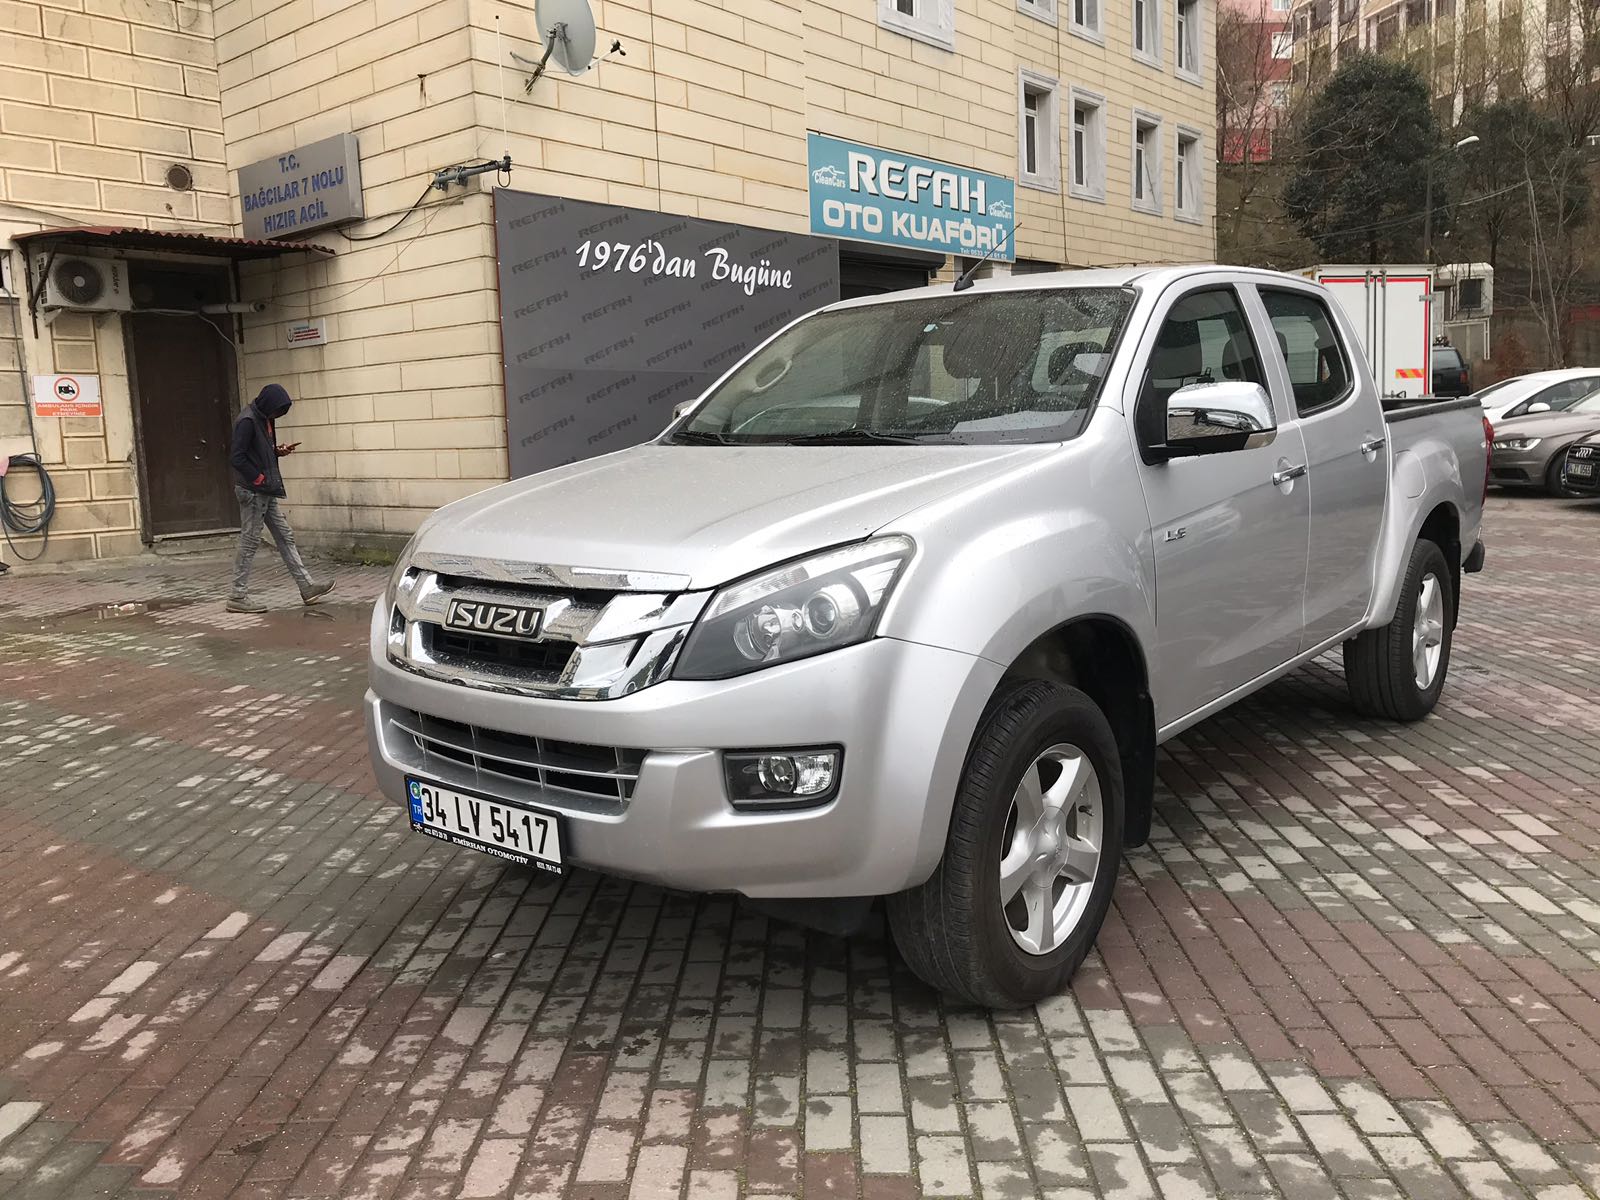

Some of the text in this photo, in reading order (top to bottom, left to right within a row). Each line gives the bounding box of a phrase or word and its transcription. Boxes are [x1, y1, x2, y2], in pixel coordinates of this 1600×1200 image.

[279, 154, 300, 173] T.C.
[302, 177, 308, 195] 7
[311, 166, 345, 192] NOLU
[848, 151, 987, 215] REFAH
[264, 209, 297, 233] HIZIR
[508, 203, 565, 230] REFAH
[577, 213, 630, 238] REFAH
[823, 199, 1007, 252] OTO KUAFÖRÜ
[641, 222, 688, 243] REFAH
[512, 247, 567, 274] REFAH
[576, 240, 696, 278] 1976'dan
[704, 248, 793, 295] Bugüne
[513, 290, 569, 319] REFAH
[581, 295, 633, 323] REFAH
[644, 301, 691, 327] REFAH
[516, 332, 571, 363] REFAH
[584, 335, 635, 365] REFAH
[646, 339, 693, 367] REFAH
[519, 372, 574, 404] REFAH
[586, 374, 637, 404] REFAH
[521, 414, 576, 447] REFAH
[587, 414, 638, 445] REFAH
[447, 601, 540, 635] ISUZU
[413, 804, 423, 816] TR
[421, 788, 549, 854] 34 LV 5417
[452, 836, 529, 865] EMİRHAN OTOMOTİV
